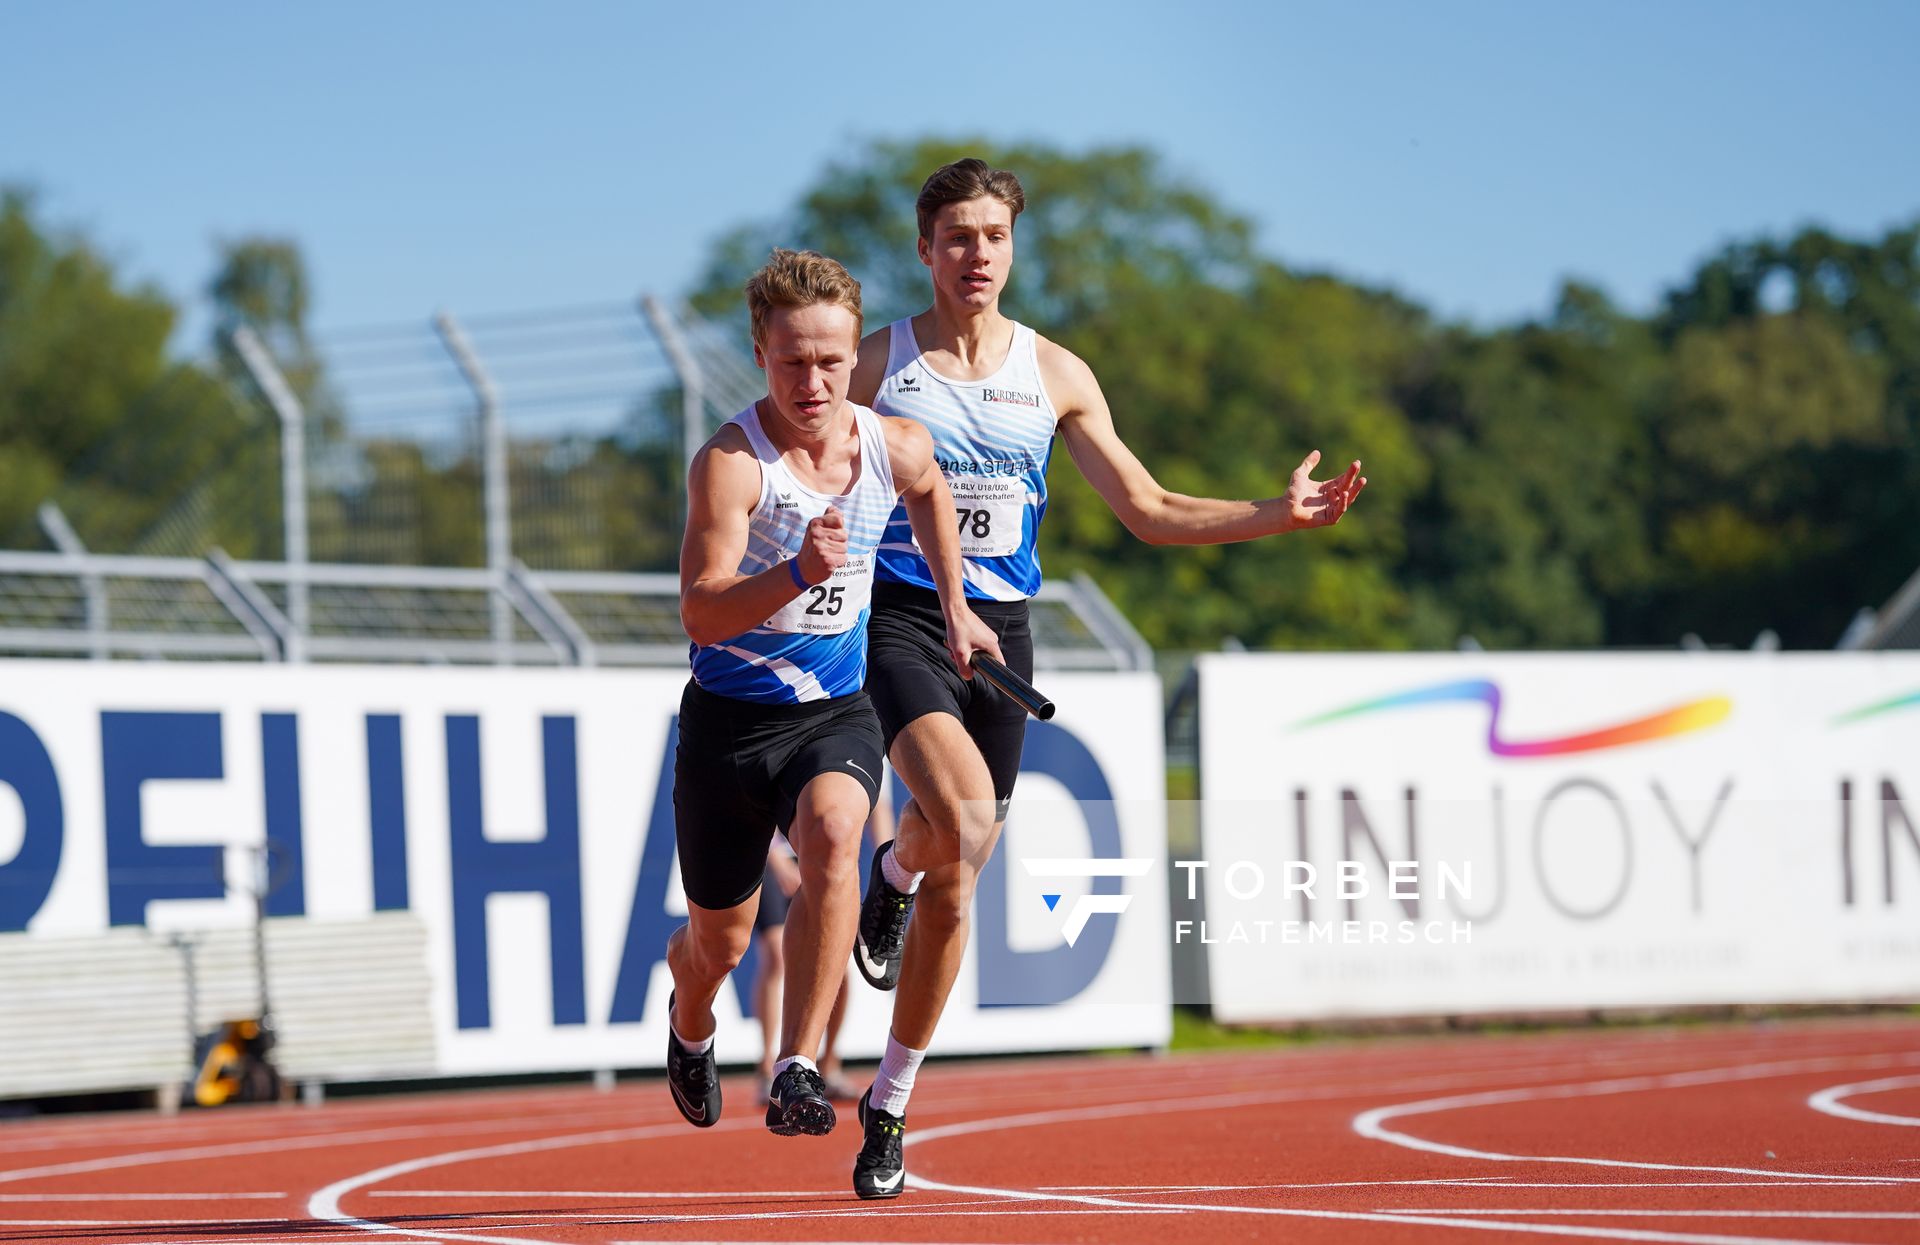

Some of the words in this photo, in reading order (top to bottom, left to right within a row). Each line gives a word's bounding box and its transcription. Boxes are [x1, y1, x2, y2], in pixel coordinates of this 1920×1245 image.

[898, 385, 920, 393] erima
[982, 388, 1040, 407] BURDENSKI
[934, 457, 978, 473] ansa
[776, 501, 798, 509] erima
[805, 585, 845, 616] 25
